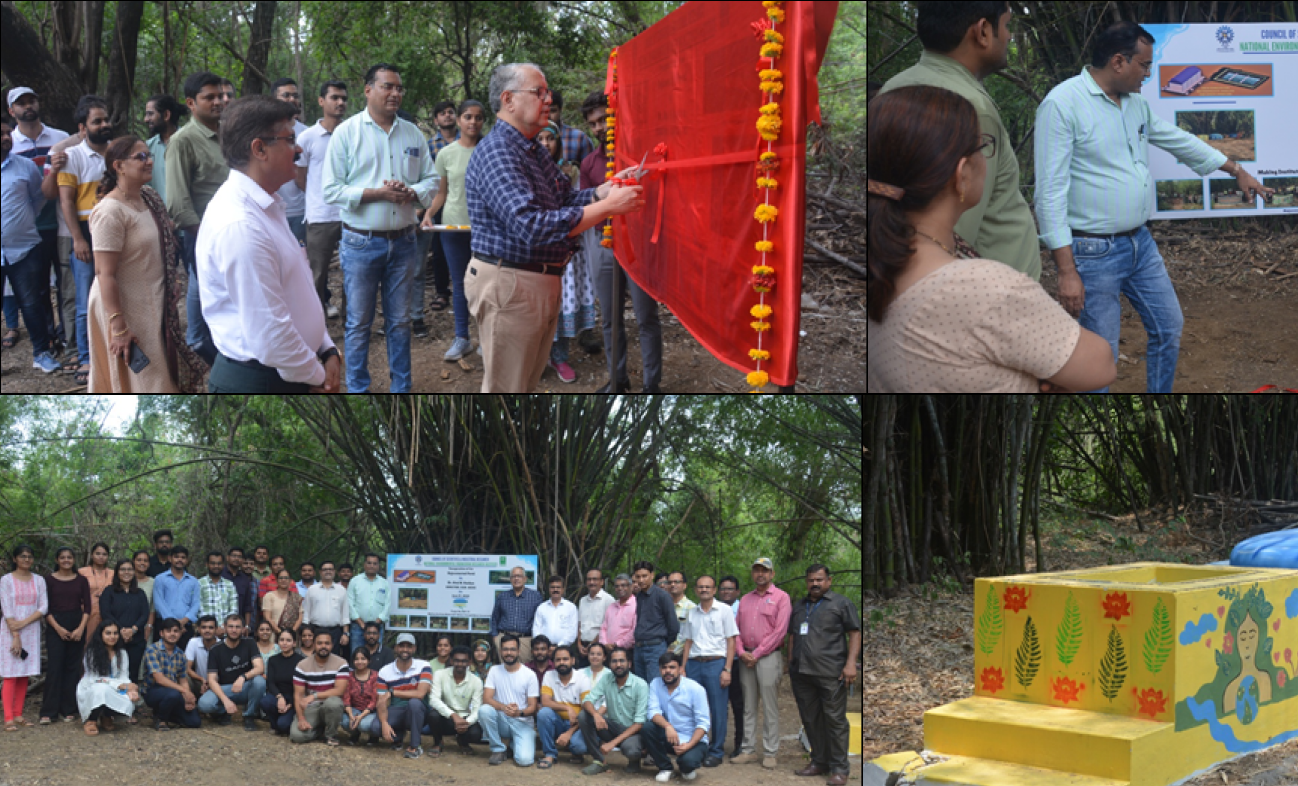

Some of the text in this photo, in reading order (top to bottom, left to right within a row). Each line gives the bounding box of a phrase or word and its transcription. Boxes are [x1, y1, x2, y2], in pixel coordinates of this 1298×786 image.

[1261, 29, 1287, 39] COUNCIL
[1288, 29, 1297, 39] OF
[1239, 41, 1270, 51] NATIONAL
